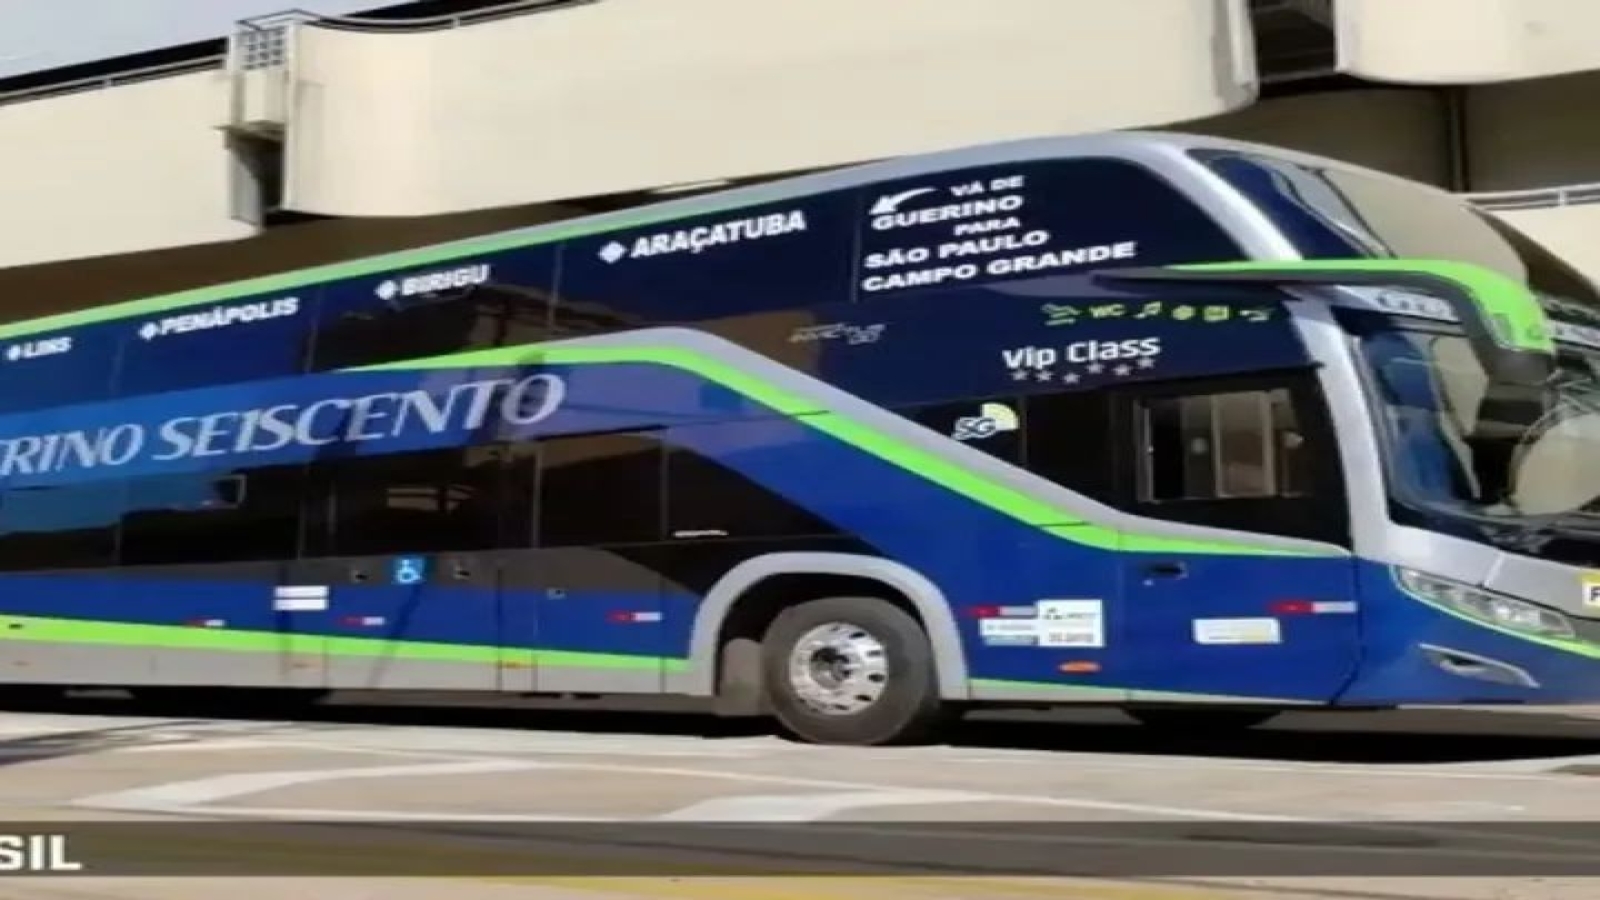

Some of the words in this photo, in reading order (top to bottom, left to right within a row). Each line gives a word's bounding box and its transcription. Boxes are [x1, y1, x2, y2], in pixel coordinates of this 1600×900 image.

[990, 175, 1025, 191] DE
[871, 194, 1024, 230] GUERINO
[953, 216, 1021, 236] PARA
[629, 210, 806, 254] ARAÇATUBA
[938, 230, 1050, 259] PAULO
[401, 264, 491, 296] BIRIGU
[861, 263, 978, 292] CAMPO
[986, 241, 1138, 275] GRANDE
[159, 297, 299, 335] PENÁPOLIS
[1089, 303, 1125, 319] WC
[1002, 346, 1056, 370] Vip
[1066, 336, 1162, 363] Class
[0, 423, 144, 476] RINO
[153, 374, 566, 461] SEISCENTO
